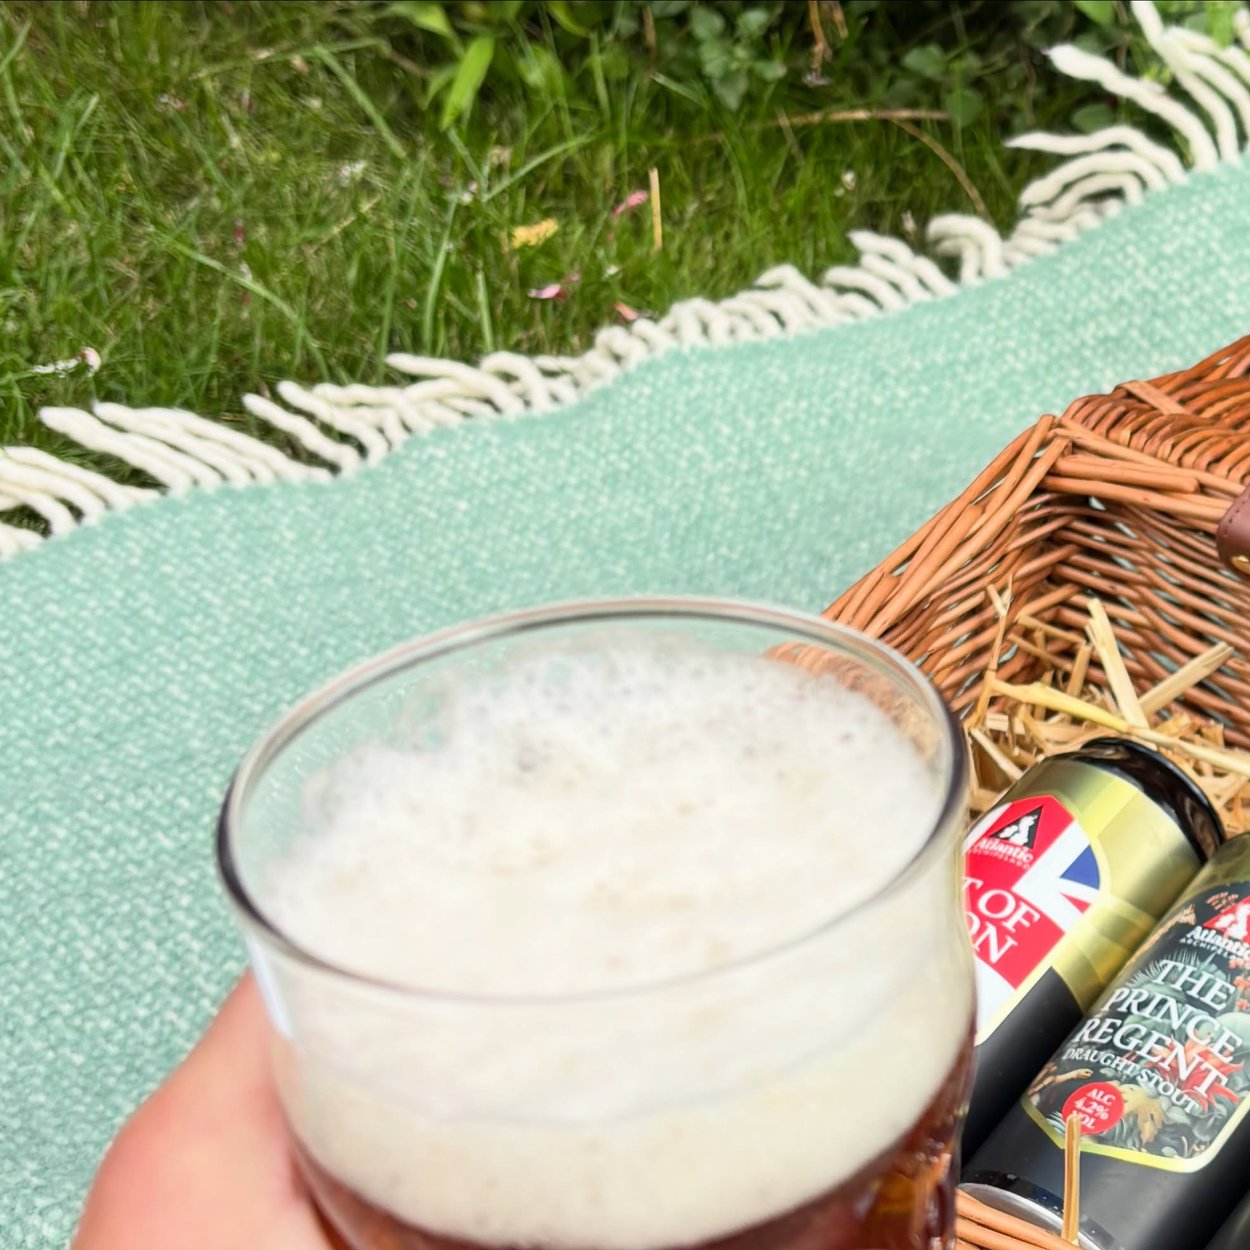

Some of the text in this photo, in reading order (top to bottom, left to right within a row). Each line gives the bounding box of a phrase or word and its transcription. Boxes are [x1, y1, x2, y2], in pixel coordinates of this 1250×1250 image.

[978, 889, 1041, 933] OF
[1153, 959, 1236, 1012] THE
[1101, 987, 1244, 1063] PRINCE
[1061, 1048, 1200, 1114] DRAUGHT STOUT
[1072, 1017, 1229, 1098] REGENT
[1074, 1096, 1110, 1120] 4.2%
[1086, 1088, 1116, 1106] ALC
